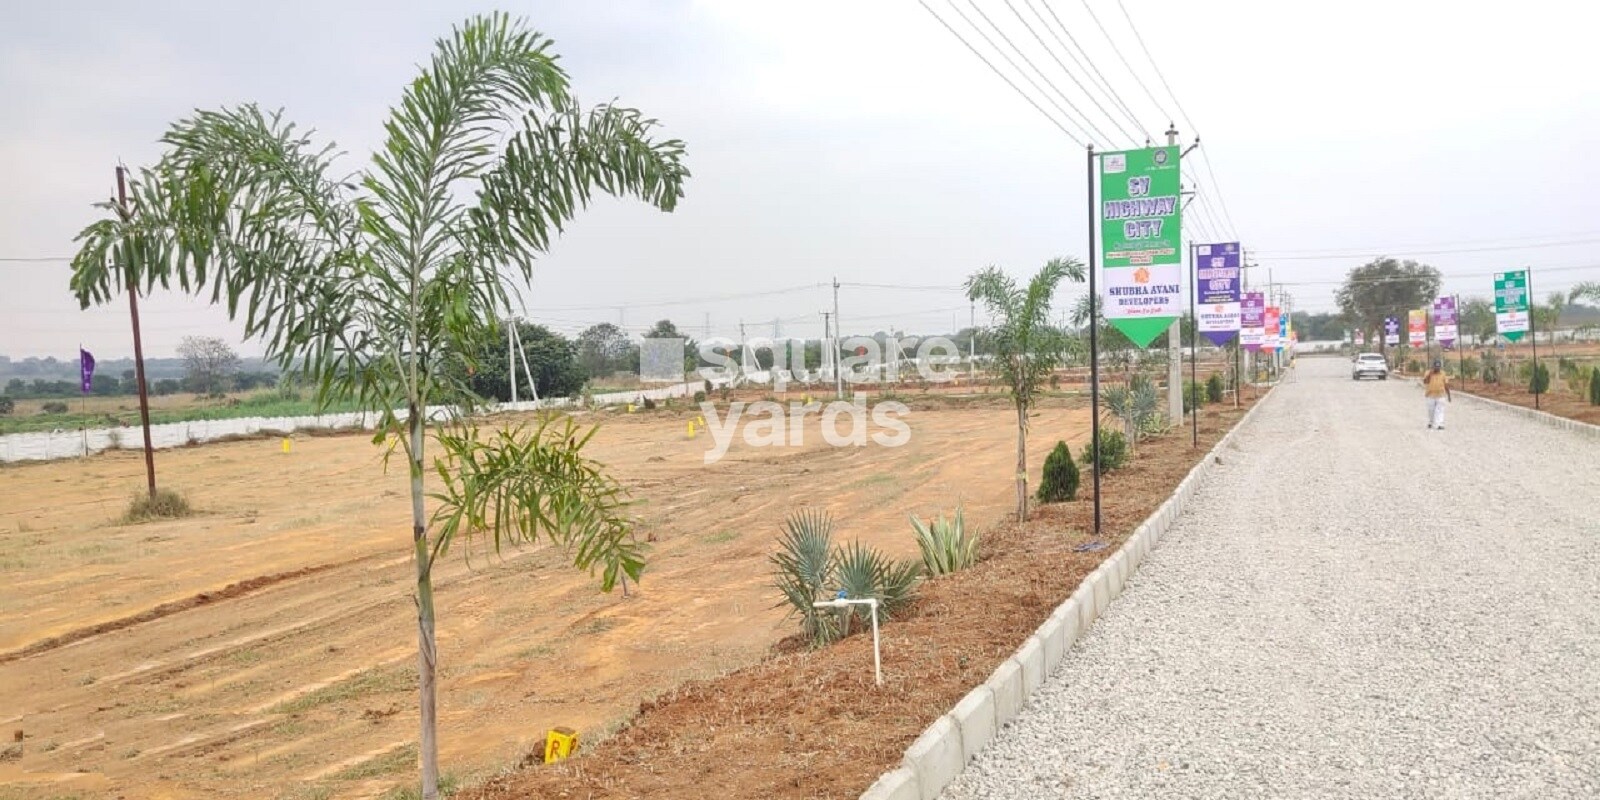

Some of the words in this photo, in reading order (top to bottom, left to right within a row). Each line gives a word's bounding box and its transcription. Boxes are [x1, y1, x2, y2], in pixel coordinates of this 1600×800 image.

[1128, 177, 1150, 196] SV
[1105, 196, 1176, 219] HIGHWAY
[1124, 219, 1163, 239] CITY
[1109, 286, 1149, 296] SHUBHA
[1150, 284, 1180, 295] AVANI
[1118, 297, 1170, 306] DEVELOPERS
[549, 740, 560, 758] R
